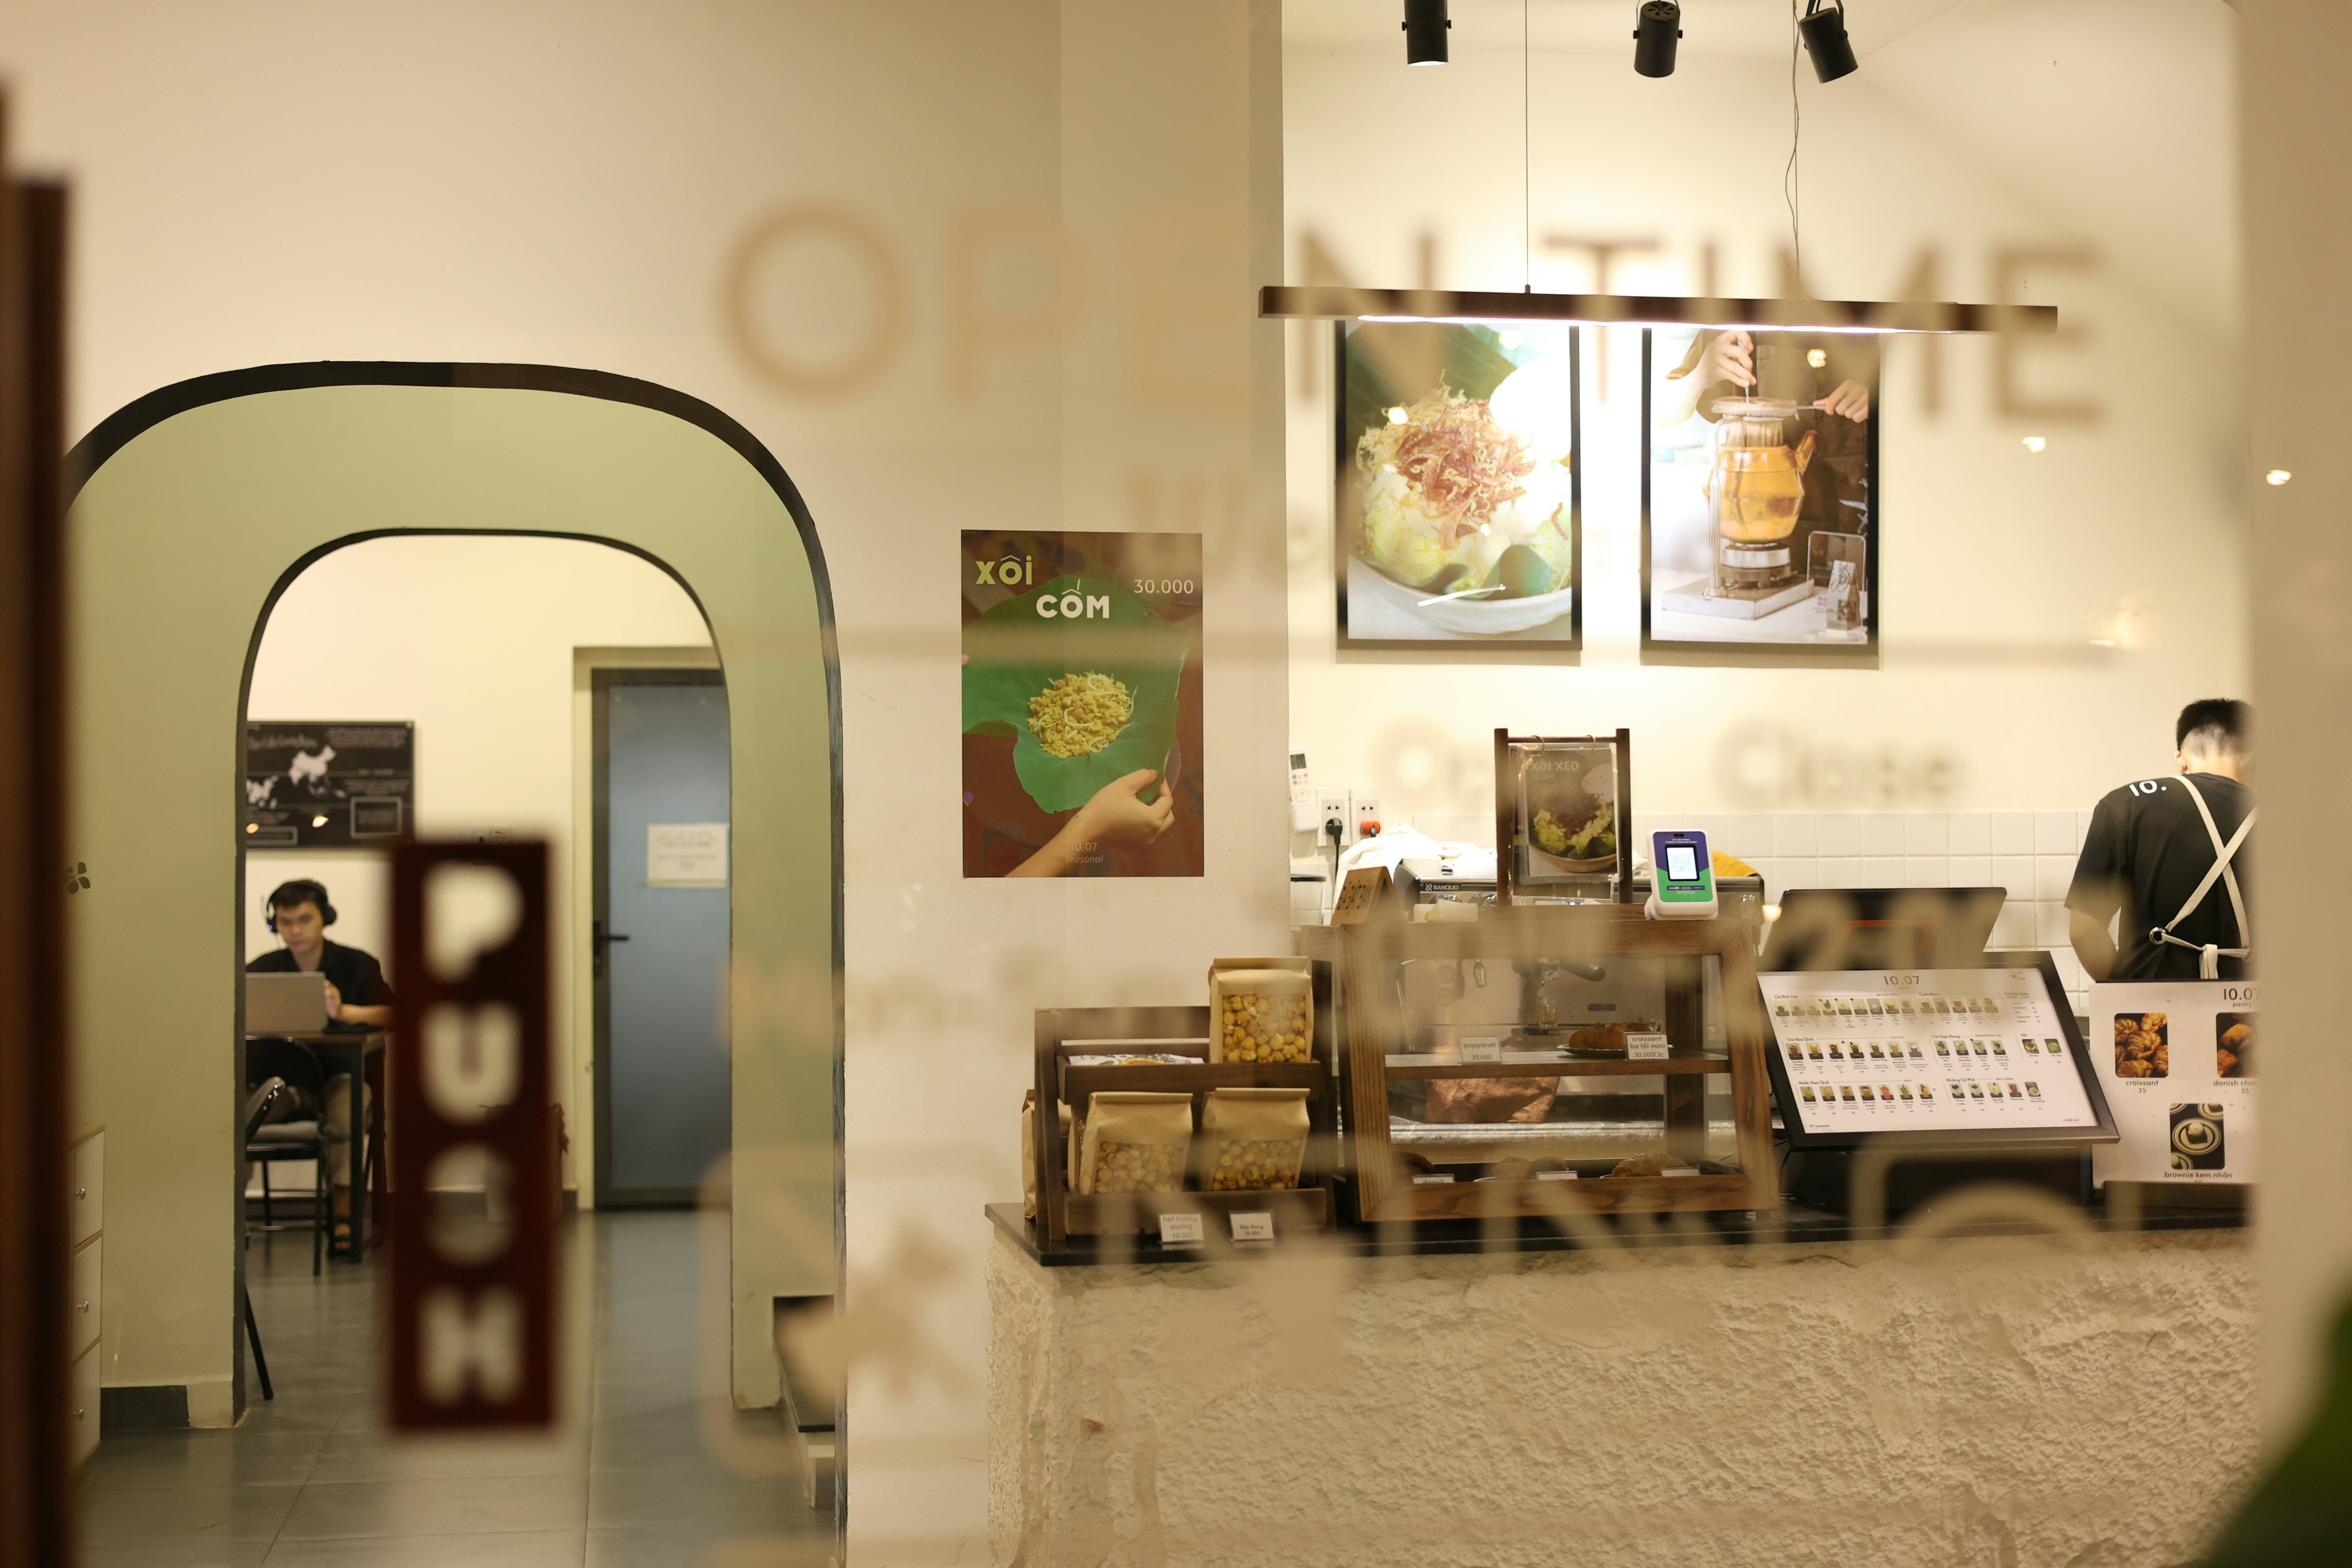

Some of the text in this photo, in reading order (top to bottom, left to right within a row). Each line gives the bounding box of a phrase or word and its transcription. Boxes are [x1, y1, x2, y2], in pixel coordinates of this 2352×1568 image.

[723, 202, 2105, 429] OPEN TIME
[1134, 579, 1193, 593] 30.000
[1531, 759, 1551, 771] XÔI
[1072, 842, 1097, 851] 10.07
[1066, 855, 1103, 863] seasonal
[1884, 976, 1919, 985] 10.07
